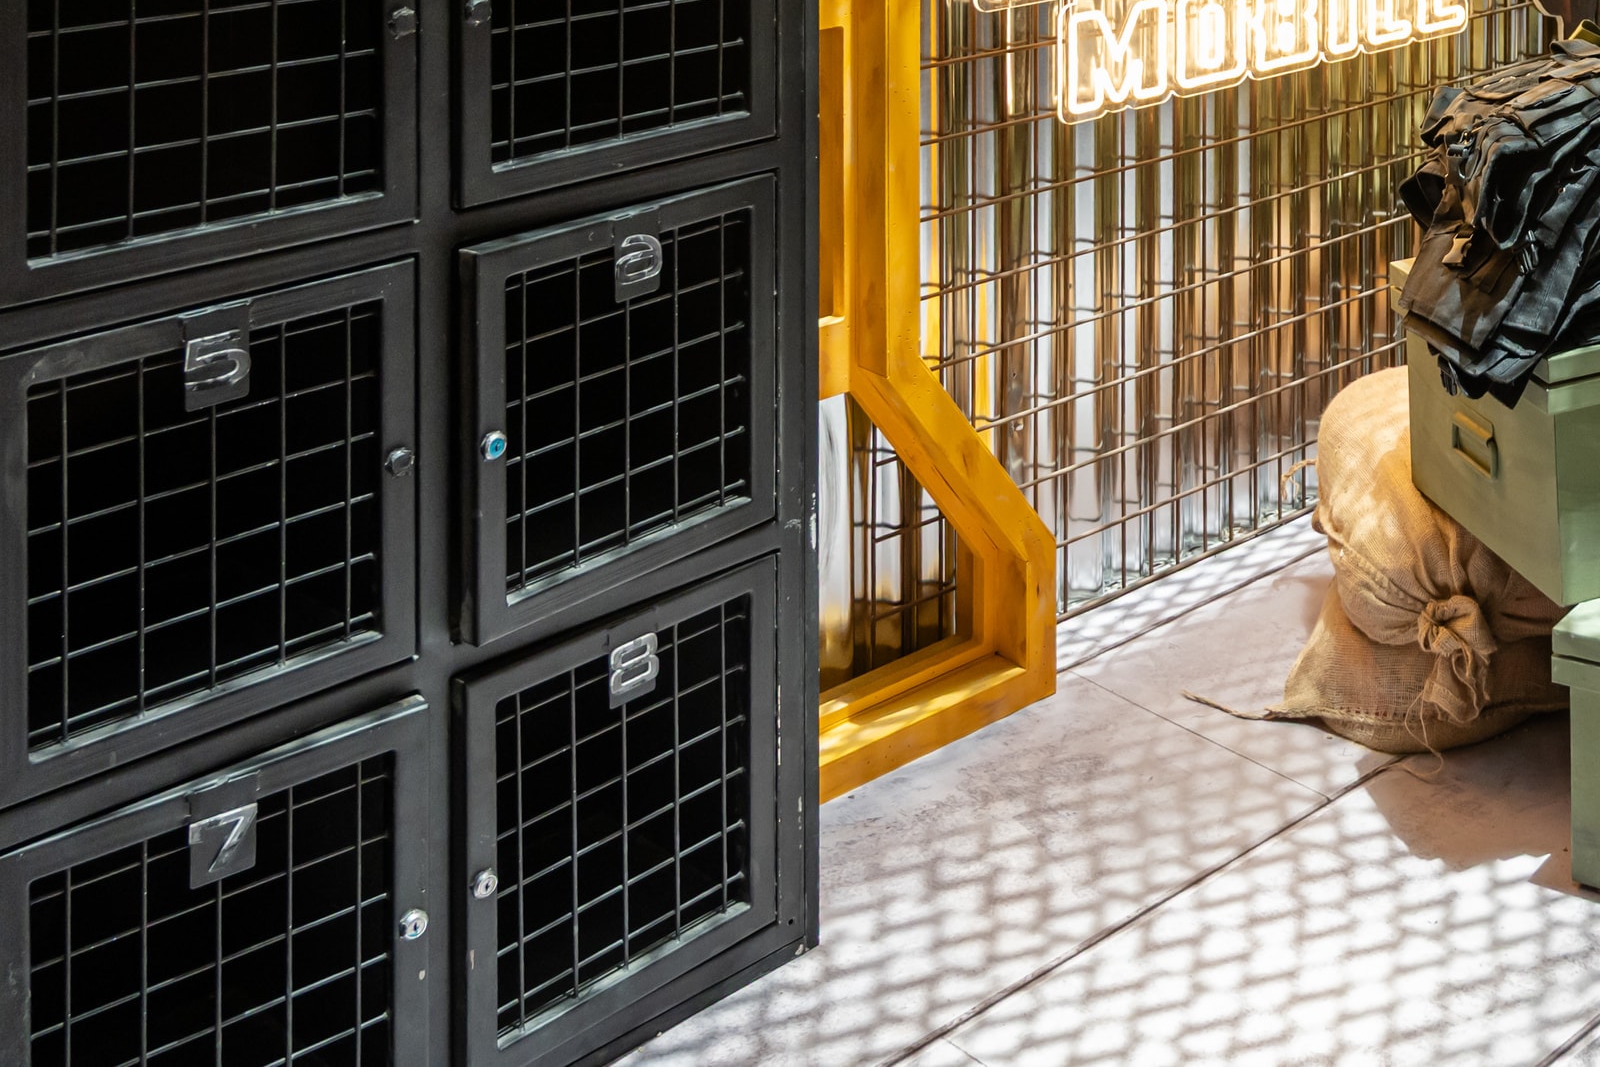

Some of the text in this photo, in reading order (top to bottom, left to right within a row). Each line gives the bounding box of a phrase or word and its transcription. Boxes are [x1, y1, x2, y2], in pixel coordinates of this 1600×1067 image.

[184, 328, 251, 392] 5
[609, 632, 660, 696] 8
[188, 801, 258, 874] 7
